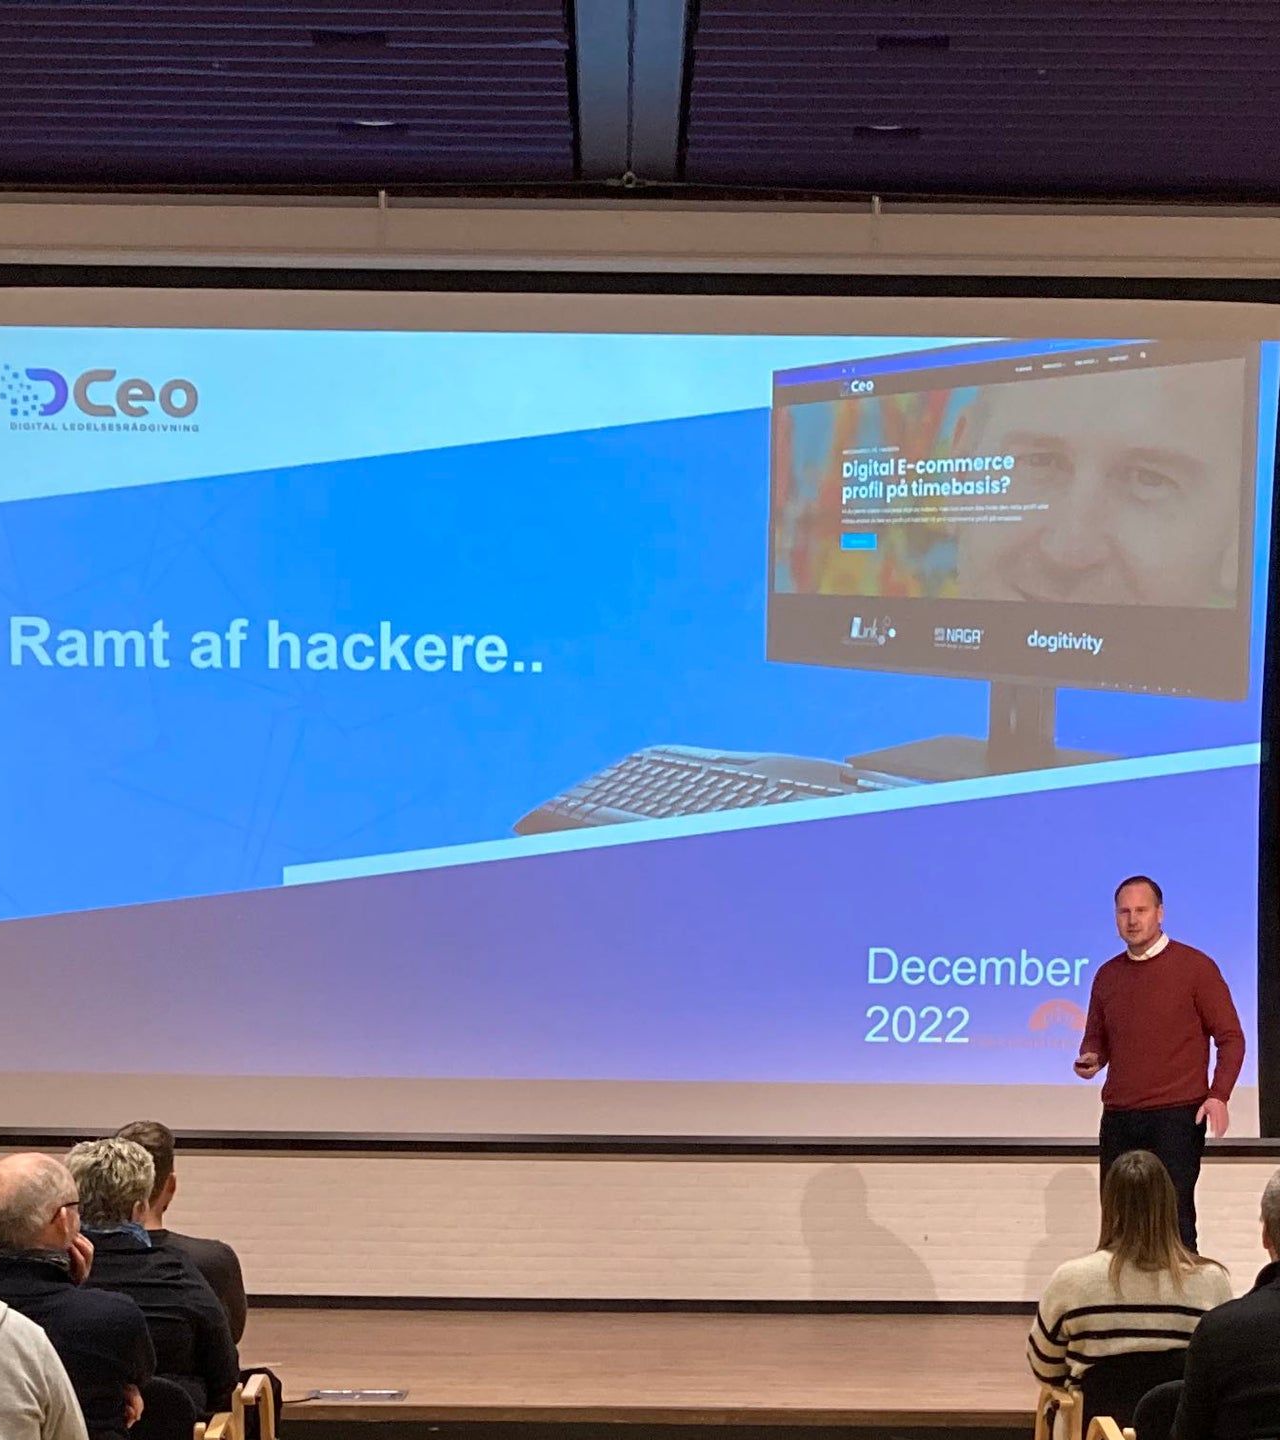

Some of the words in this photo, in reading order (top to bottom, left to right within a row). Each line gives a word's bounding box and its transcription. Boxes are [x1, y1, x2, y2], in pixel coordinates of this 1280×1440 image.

[9, 421, 58, 431] DIGITAL
[62, 422, 200, 433] LEDELSESRÅDGIVNING
[842, 458, 894, 481] Digital
[897, 455, 1015, 475] E-commerce
[842, 480, 883, 505] profil
[886, 479, 908, 503] på
[911, 475, 1011, 497] timebasis?
[9, 616, 170, 668] Ramt
[190, 618, 250, 669] af
[267, 619, 543, 673] hackere..
[946, 627, 981, 643] NAGA
[1027, 629, 1104, 655] dogitivity
[867, 947, 1090, 986] December
[864, 1005, 970, 1043] 2022
